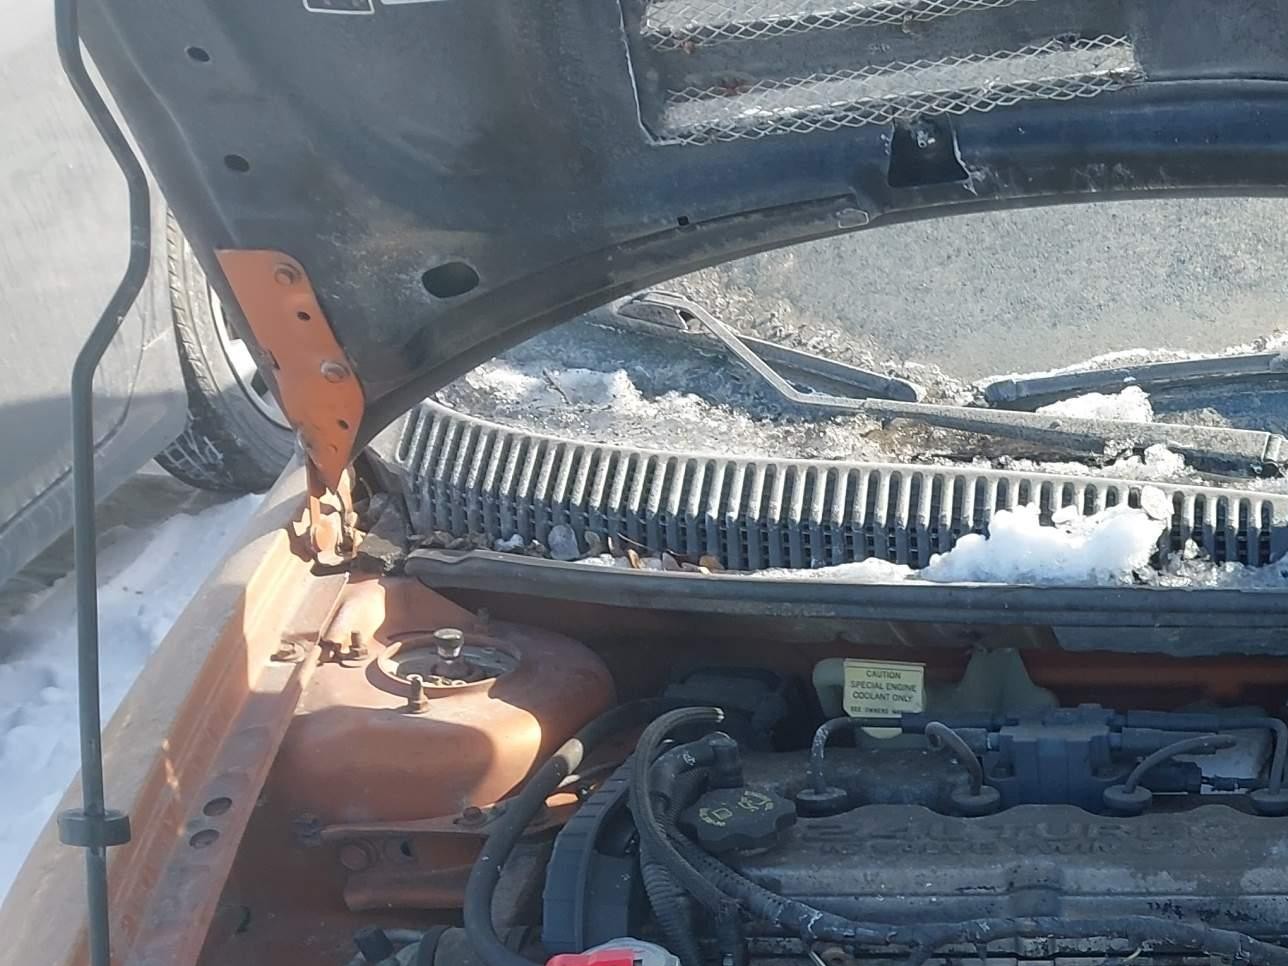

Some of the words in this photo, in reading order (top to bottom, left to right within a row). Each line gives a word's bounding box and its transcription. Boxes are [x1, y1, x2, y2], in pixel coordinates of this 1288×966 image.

[865, 670, 902, 679] CAUTION
[850, 680, 884, 690] SPECIAL
[886, 682, 917, 693] ENGINE
[852, 691, 890, 702] COOLANT
[892, 693, 914, 702] ONLY
